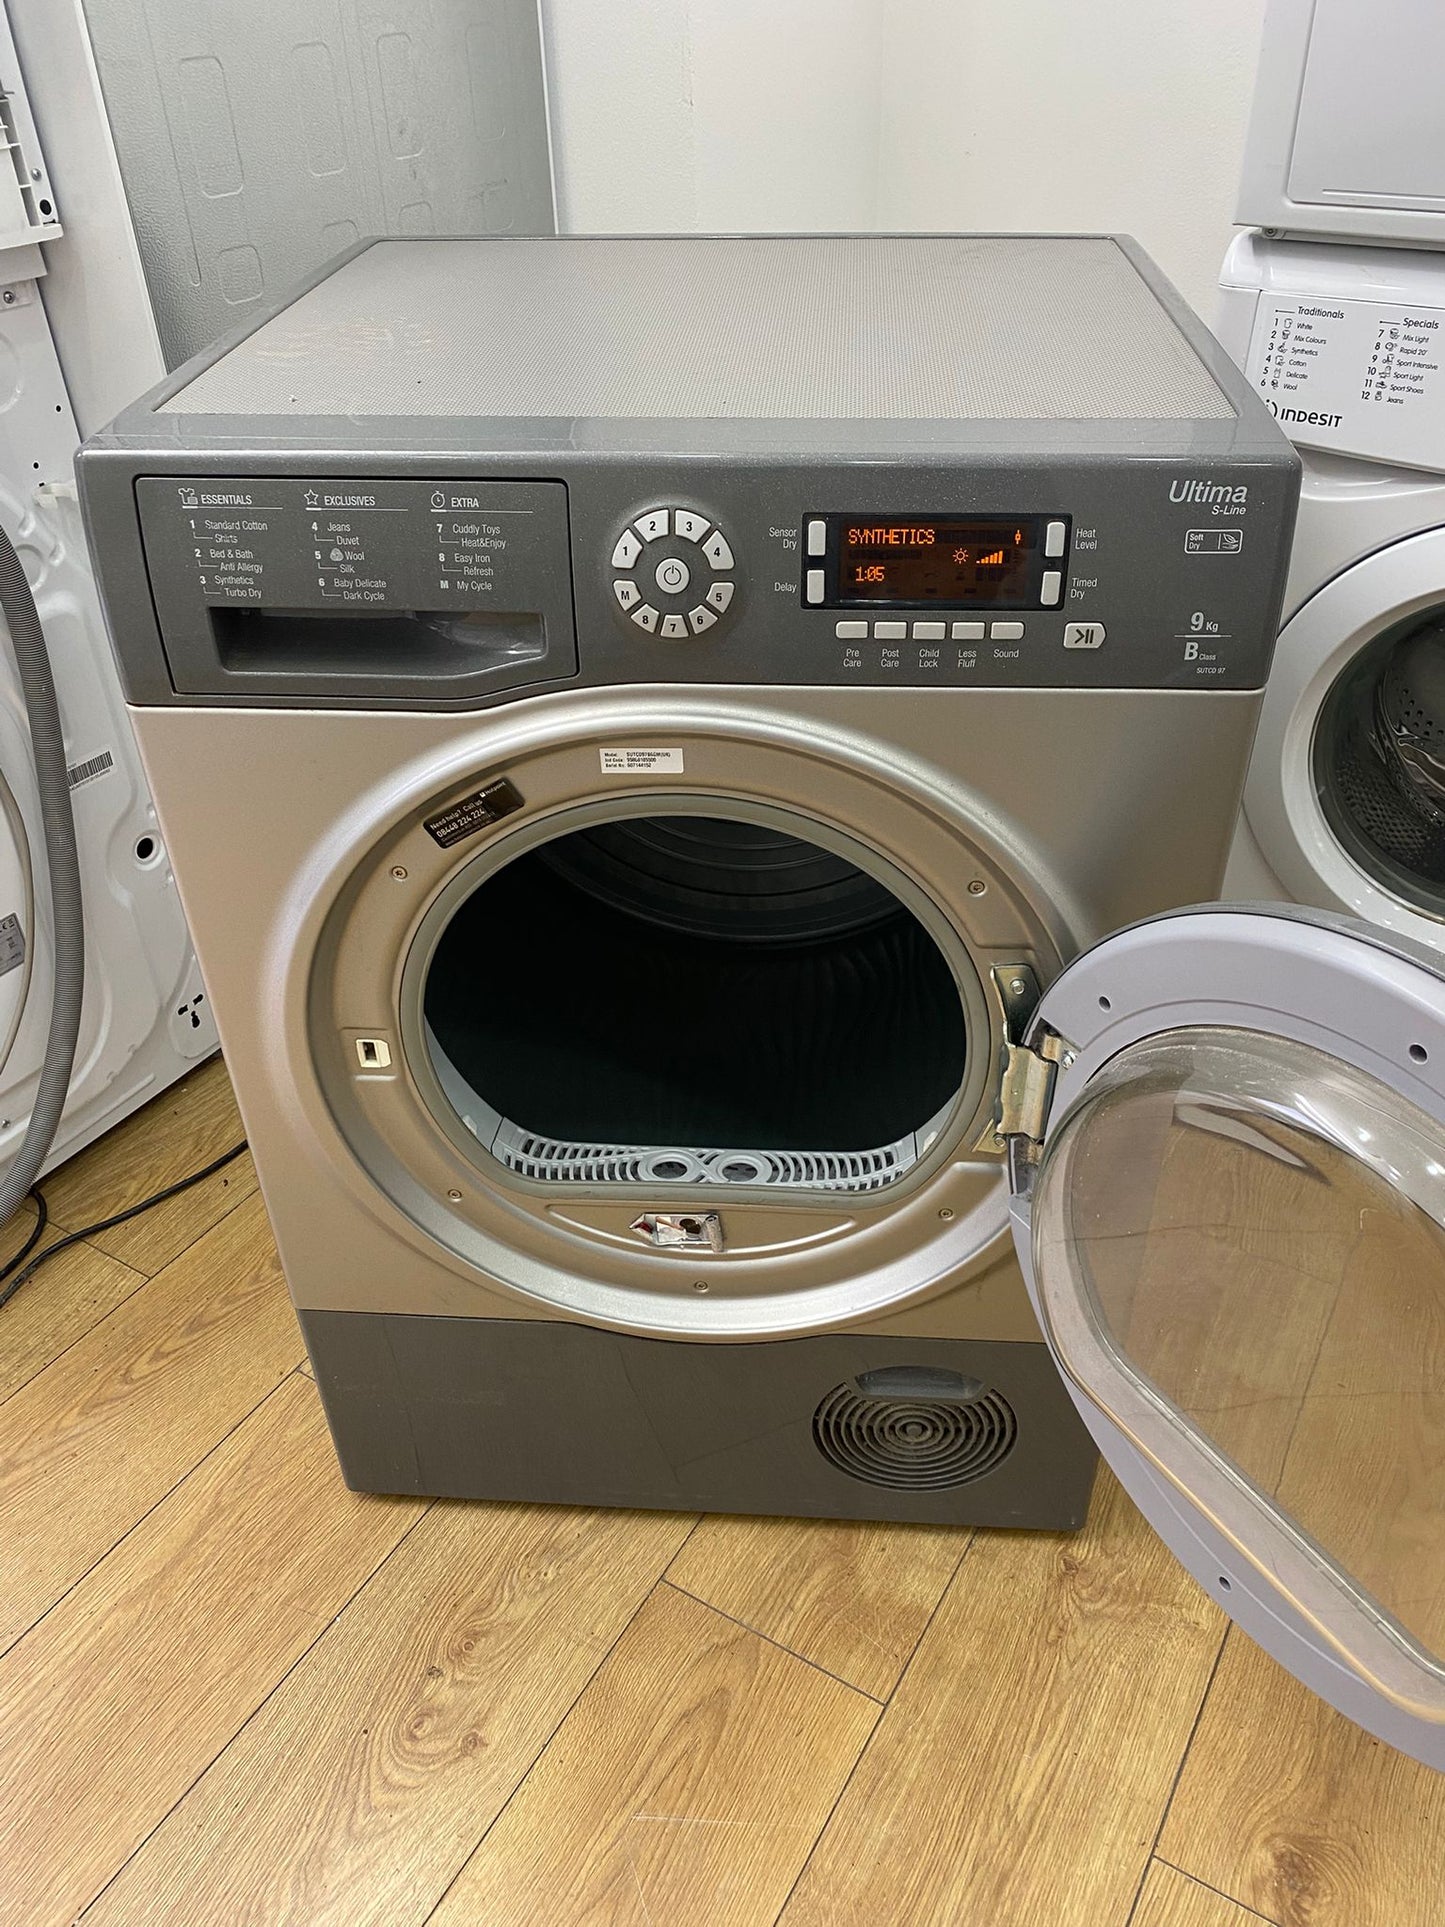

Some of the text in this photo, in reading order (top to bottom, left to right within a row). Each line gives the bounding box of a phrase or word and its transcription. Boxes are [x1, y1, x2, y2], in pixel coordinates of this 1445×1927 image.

[1298, 306, 1344, 319] Traditionals
[1274, 318, 1313, 330] 1 White
[1403, 318, 1439, 329] Specials
[1271, 330, 1277, 338] 2
[1306, 336, 1326, 344] Colours
[1378, 329, 1385, 338] 7
[1415, 336, 1429, 344] Light
[1291, 347, 1318, 356] Synthetics
[1375, 342, 1380, 350] 8
[1400, 347, 1417, 355] Rapid
[1289, 359, 1307, 367] Cotton
[1372, 355, 1438, 370] 9 Sport Intensive
[1286, 371, 1308, 379] Delicate
[1368, 367, 1376, 375] 10
[1409, 374, 1424, 382] Light
[1365, 379, 1372, 388] 11
[1406, 386, 1424, 394] Shoes
[1362, 391, 1404, 404] 12 Jeans
[1280, 408, 1342, 427] INDESIT
[1169, 480, 1248, 503] Ultima
[201, 495, 252, 504] ESSENTIALS
[324, 496, 375, 506] EXCLUSIVES
[451, 498, 479, 507] EXTRA
[1212, 505, 1246, 515] S-Line
[190, 520, 268, 530] 1 Standard Cotton
[312, 522, 351, 531] 4 Jeans
[437, 524, 500, 536] 7 Cuddly Toys
[650, 521, 656, 531] 2
[686, 522, 693, 531] 3
[769, 527, 797, 537] Sensor
[848, 529, 935, 544] SYNTHETICS
[1076, 528, 1096, 538] Heat
[1189, 533, 1204, 541] Soft
[215, 534, 238, 543] Shirts
[337, 536, 359, 545] Duvet
[462, 538, 506, 549] Heat&Enjoy
[783, 539, 797, 550] Dry
[1075, 540, 1097, 550] Level
[1189, 542, 1200, 550] Dry
[195, 549, 253, 559] 2 Bed & Bath
[315, 551, 365, 560] 5 Wool
[623, 546, 628, 556] 1
[714, 547, 720, 557] 4
[439, 553, 490, 564] 8 Easy Iron
[220, 562, 263, 573] Anti Allergy
[340, 564, 355, 573] Silk
[464, 566, 494, 575] Refresh
[855, 567, 885, 582] 1:05
[200, 575, 254, 585] 3 Synthetics
[318, 578, 386, 589] 6 Baby Delicate
[1072, 578, 1097, 587] Timed
[440, 580, 492, 592] M My Cycle
[774, 582, 797, 593] Delay
[224, 588, 262, 598] Turbo Dry
[343, 591, 385, 601] Dark Cycle
[621, 591, 629, 600] M
[716, 593, 722, 602] 5
[1071, 589, 1085, 599] Dry
[642, 615, 649, 624] 8
[697, 615, 703, 625] 6
[1190, 612, 1219, 632] 9 Kg
[670, 623, 676, 632] 7
[846, 649, 860, 658] Pre
[882, 649, 899, 658] Post
[919, 649, 939, 658] Child
[959, 649, 977, 658] Less
[993, 649, 1019, 658] Sound
[1184, 642, 1198, 660] B
[843, 659, 862, 667] Care
[881, 659, 899, 668] Care
[919, 659, 938, 668] Lock
[958, 659, 976, 668] Fluff
[430, 818, 447, 830] Need
[446, 809, 461, 820] help?
[463, 802, 475, 812] Call
[436, 822, 458, 837] 08448
[457, 815, 471, 826] 224
[471, 808, 485, 819] 224
